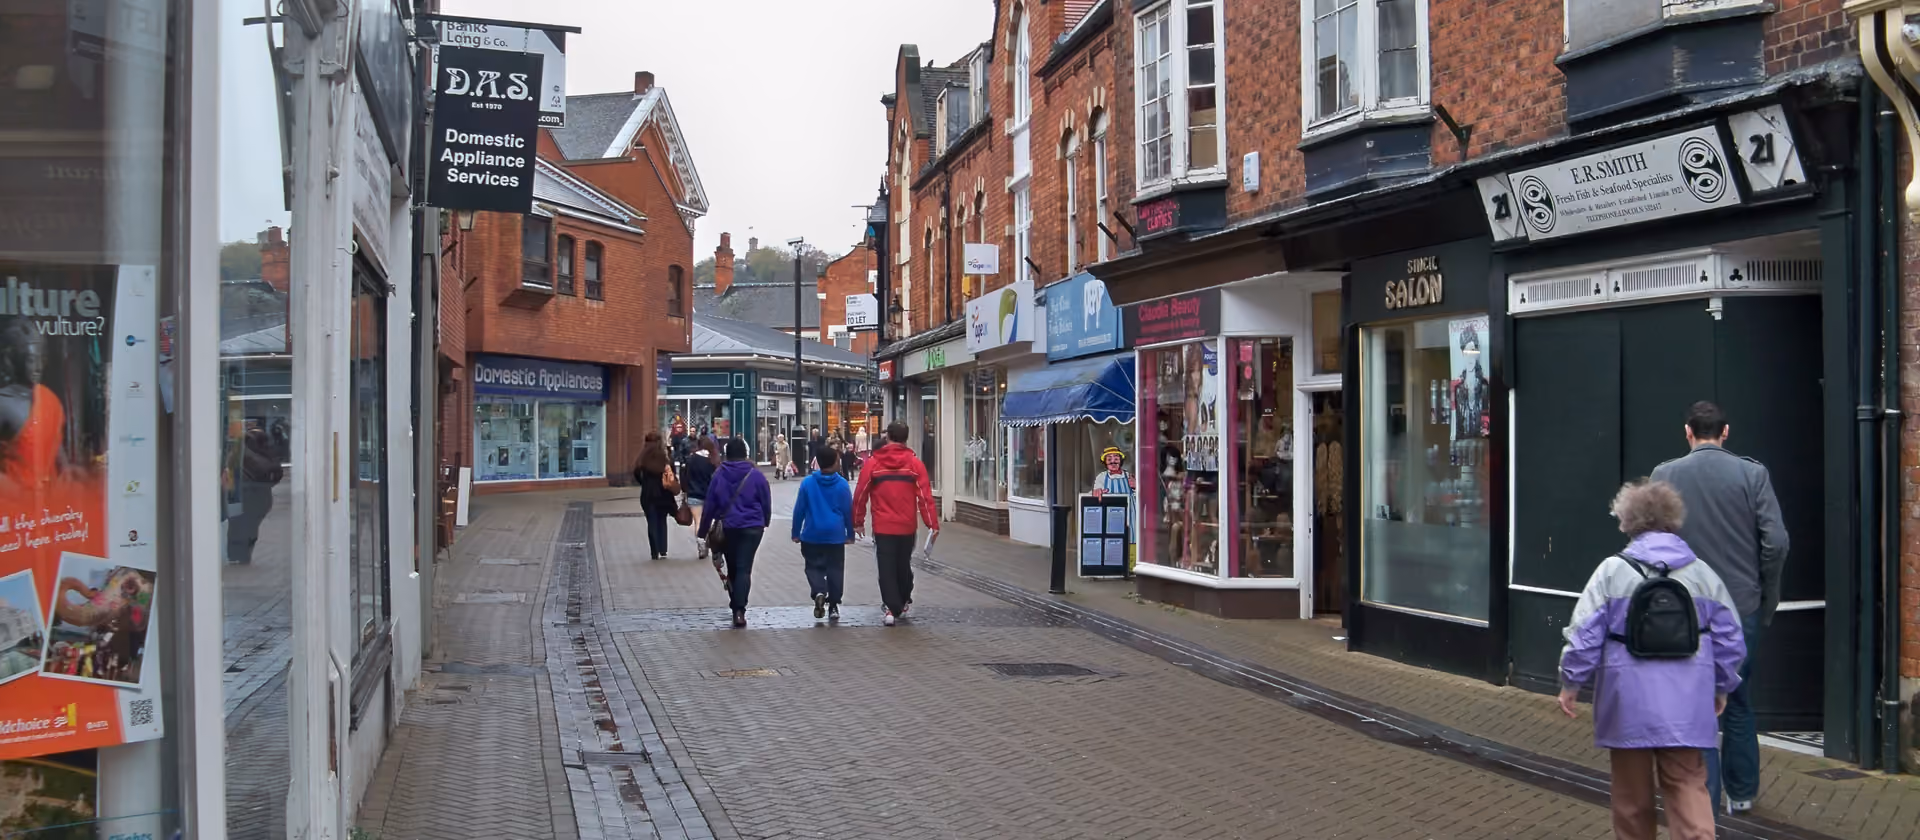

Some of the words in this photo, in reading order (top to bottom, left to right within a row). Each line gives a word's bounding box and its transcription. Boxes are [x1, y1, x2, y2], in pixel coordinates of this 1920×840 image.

[447, 32, 481, 48] Long
[483, 36, 491, 46] &
[493, 38, 508, 47] Co.
[444, 67, 533, 101] D.A.S.
[471, 101, 483, 109] Est
[485, 102, 502, 110] 1970
[445, 128, 525, 148] Domestic
[1749, 133, 1776, 164] 21
[440, 147, 525, 168] Appliance
[446, 168, 520, 187] Services
[1554, 192, 1576, 205] Fresh
[1575, 188, 1591, 201] Fish
[1591, 187, 1600, 198] &
[1599, 179, 1634, 196] Seafood
[1633, 172, 1674, 191] Specialists
[1494, 194, 1512, 220] 21
[1385, 273, 1442, 310] SALON
[1170, 297, 1200, 317] Beauty
[35, 315, 105, 336] vulture?
[855, 316, 867, 324] LET
[474, 363, 536, 386] Domestic
[539, 368, 603, 392] Appliances
